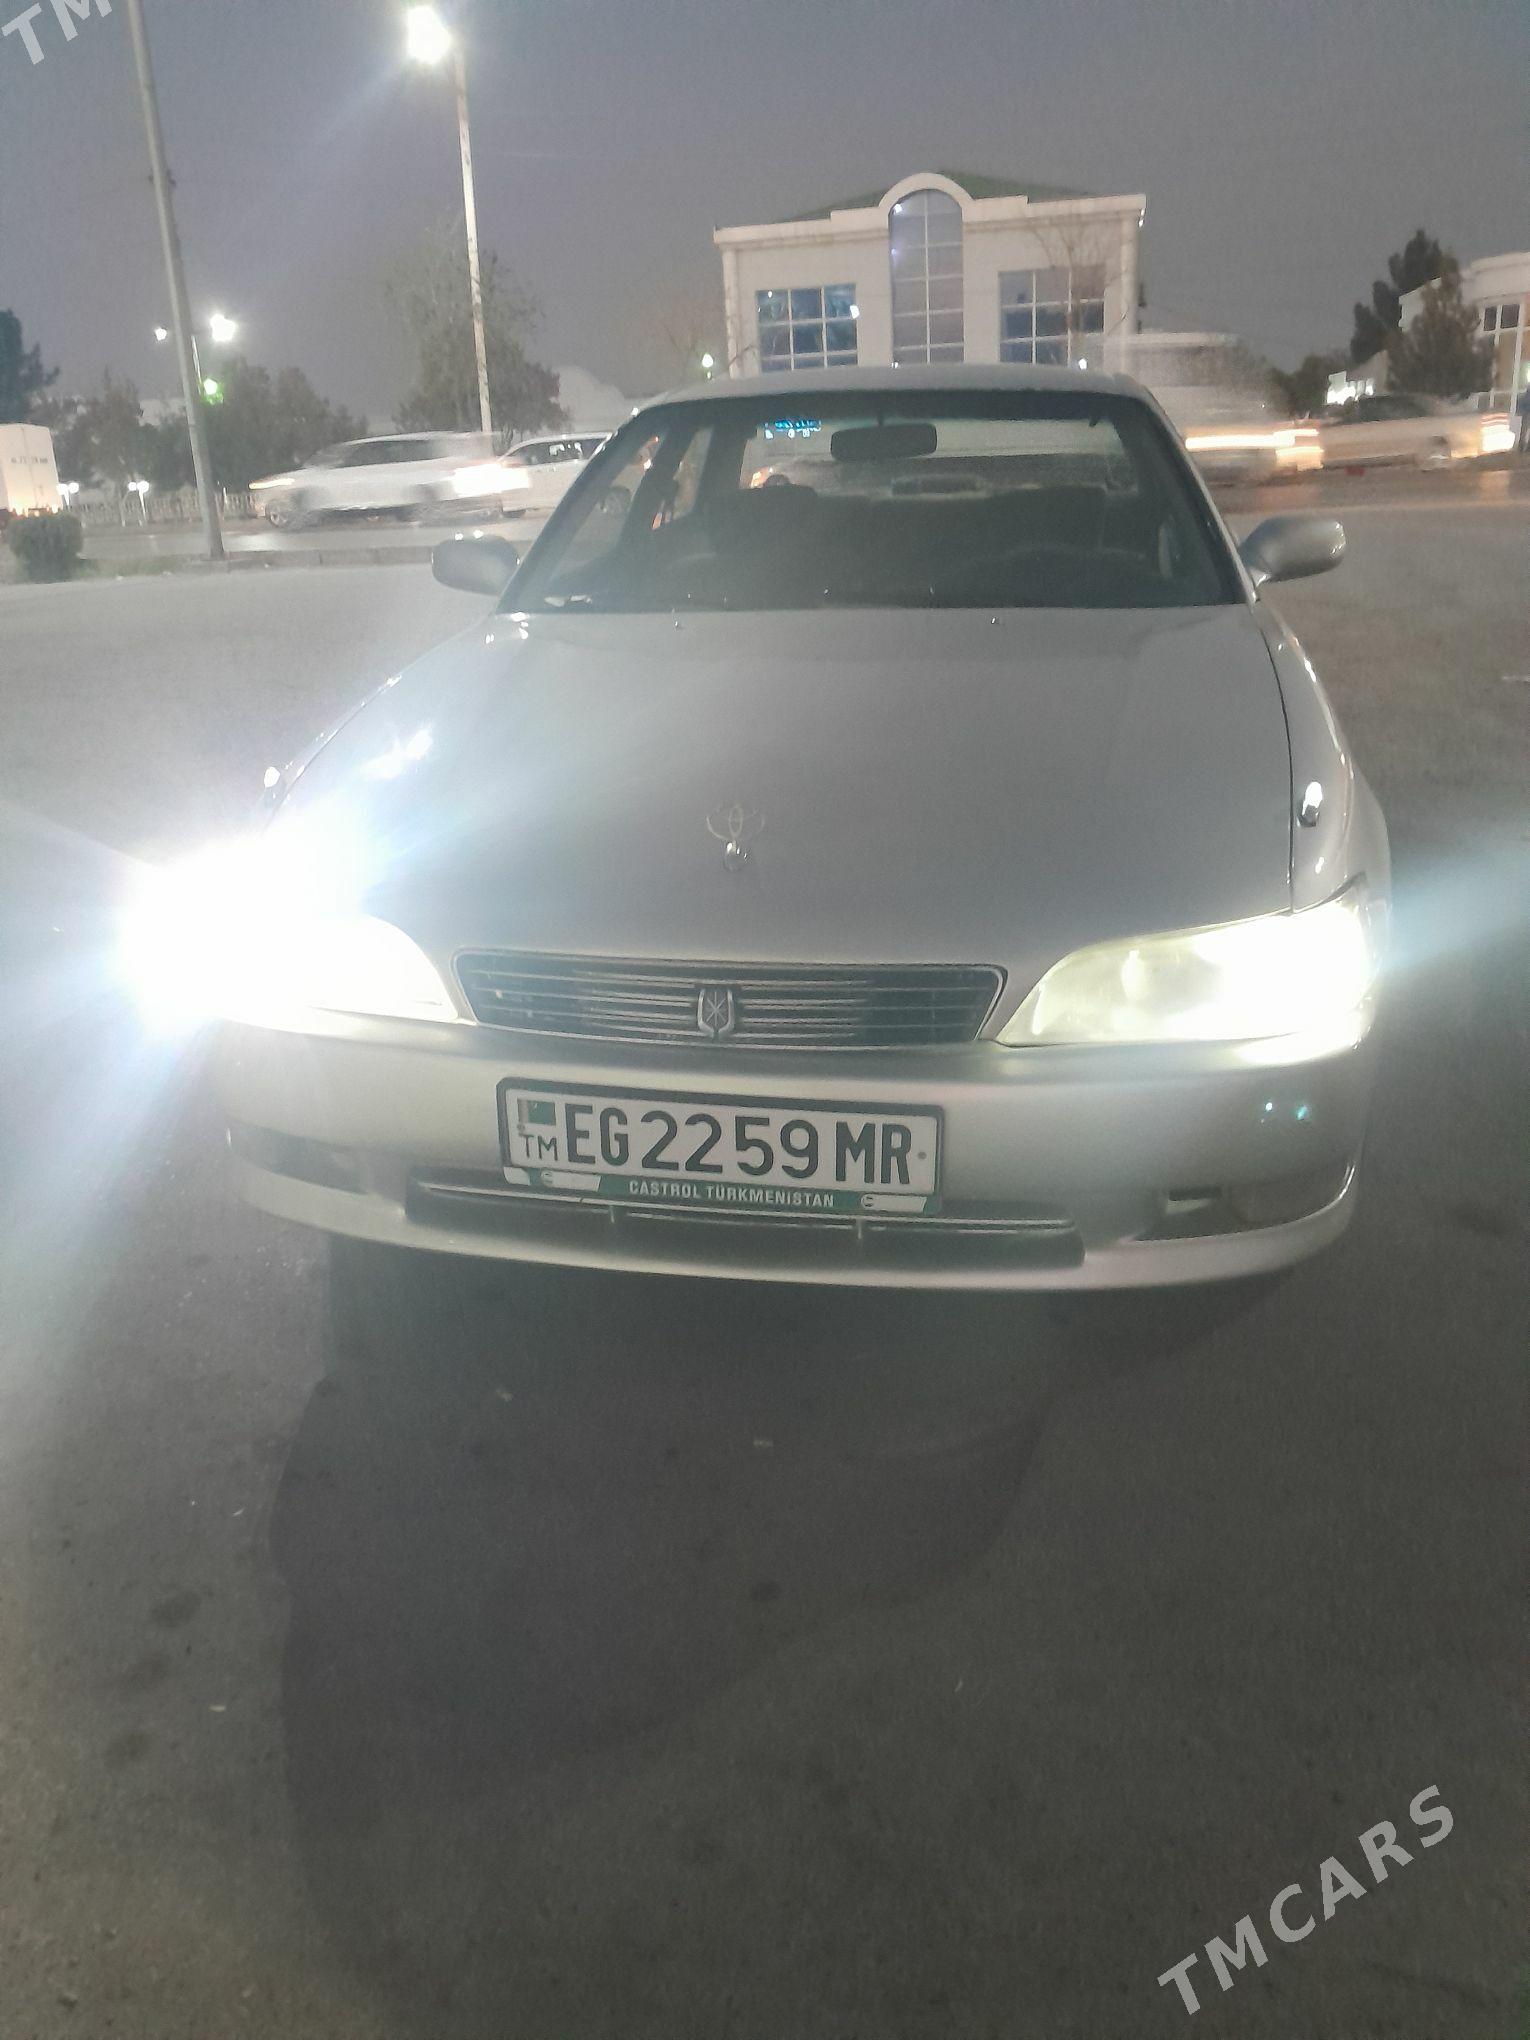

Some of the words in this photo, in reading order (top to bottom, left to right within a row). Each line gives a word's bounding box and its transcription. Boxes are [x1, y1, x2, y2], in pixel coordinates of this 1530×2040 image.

[519, 1133, 559, 1162] TM
[564, 1103, 630, 1166] EG
[639, 1110, 820, 1179] 2259
[834, 1121, 912, 1185] MR
[628, 1179, 702, 1200] CASTROL
